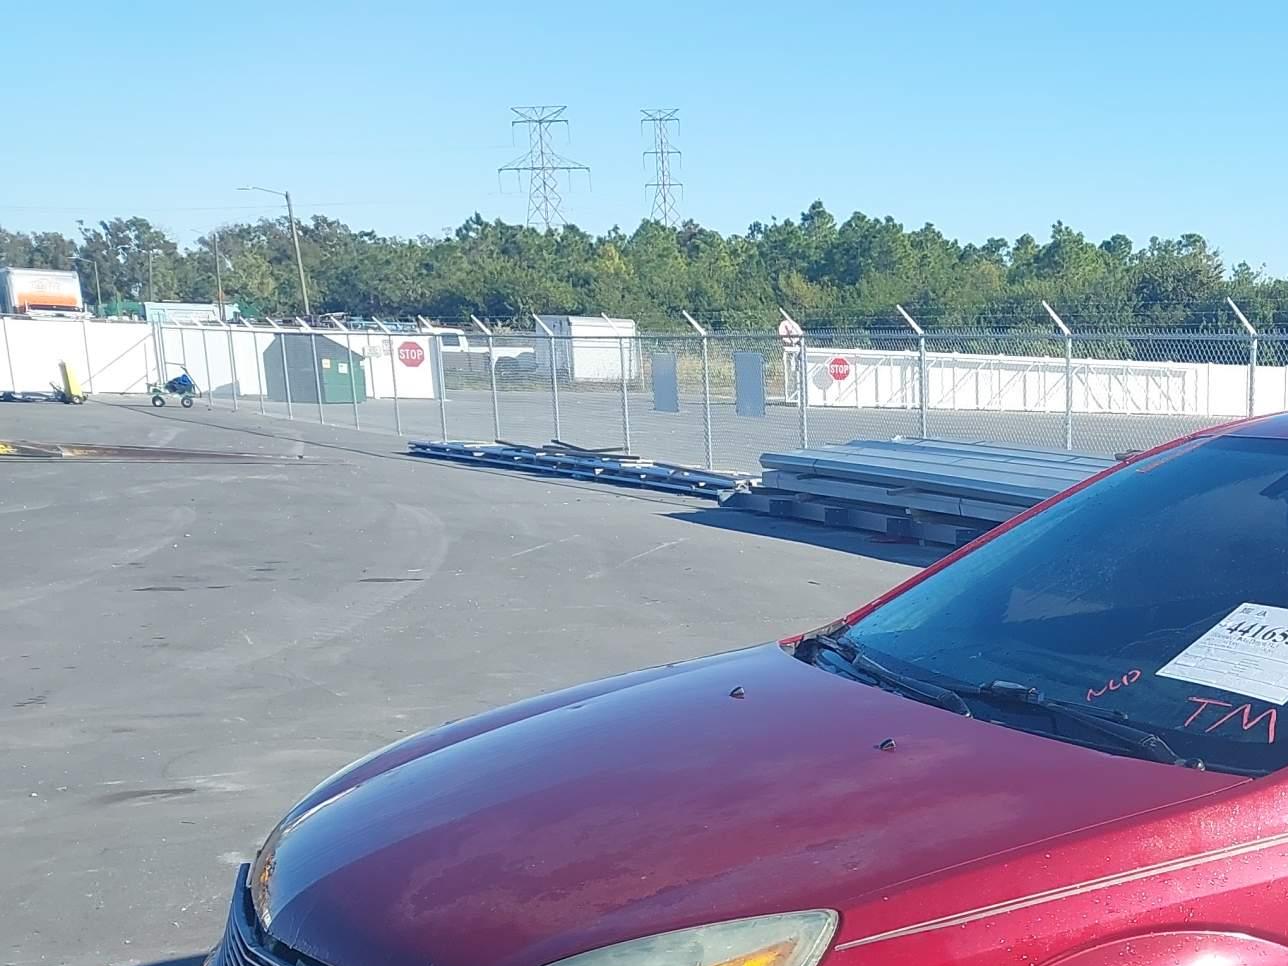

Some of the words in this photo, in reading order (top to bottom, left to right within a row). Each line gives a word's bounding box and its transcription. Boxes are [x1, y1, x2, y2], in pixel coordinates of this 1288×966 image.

[400, 349, 423, 360] STOP
[830, 364, 849, 374] STOP
[1184, 696, 1278, 744] TM
